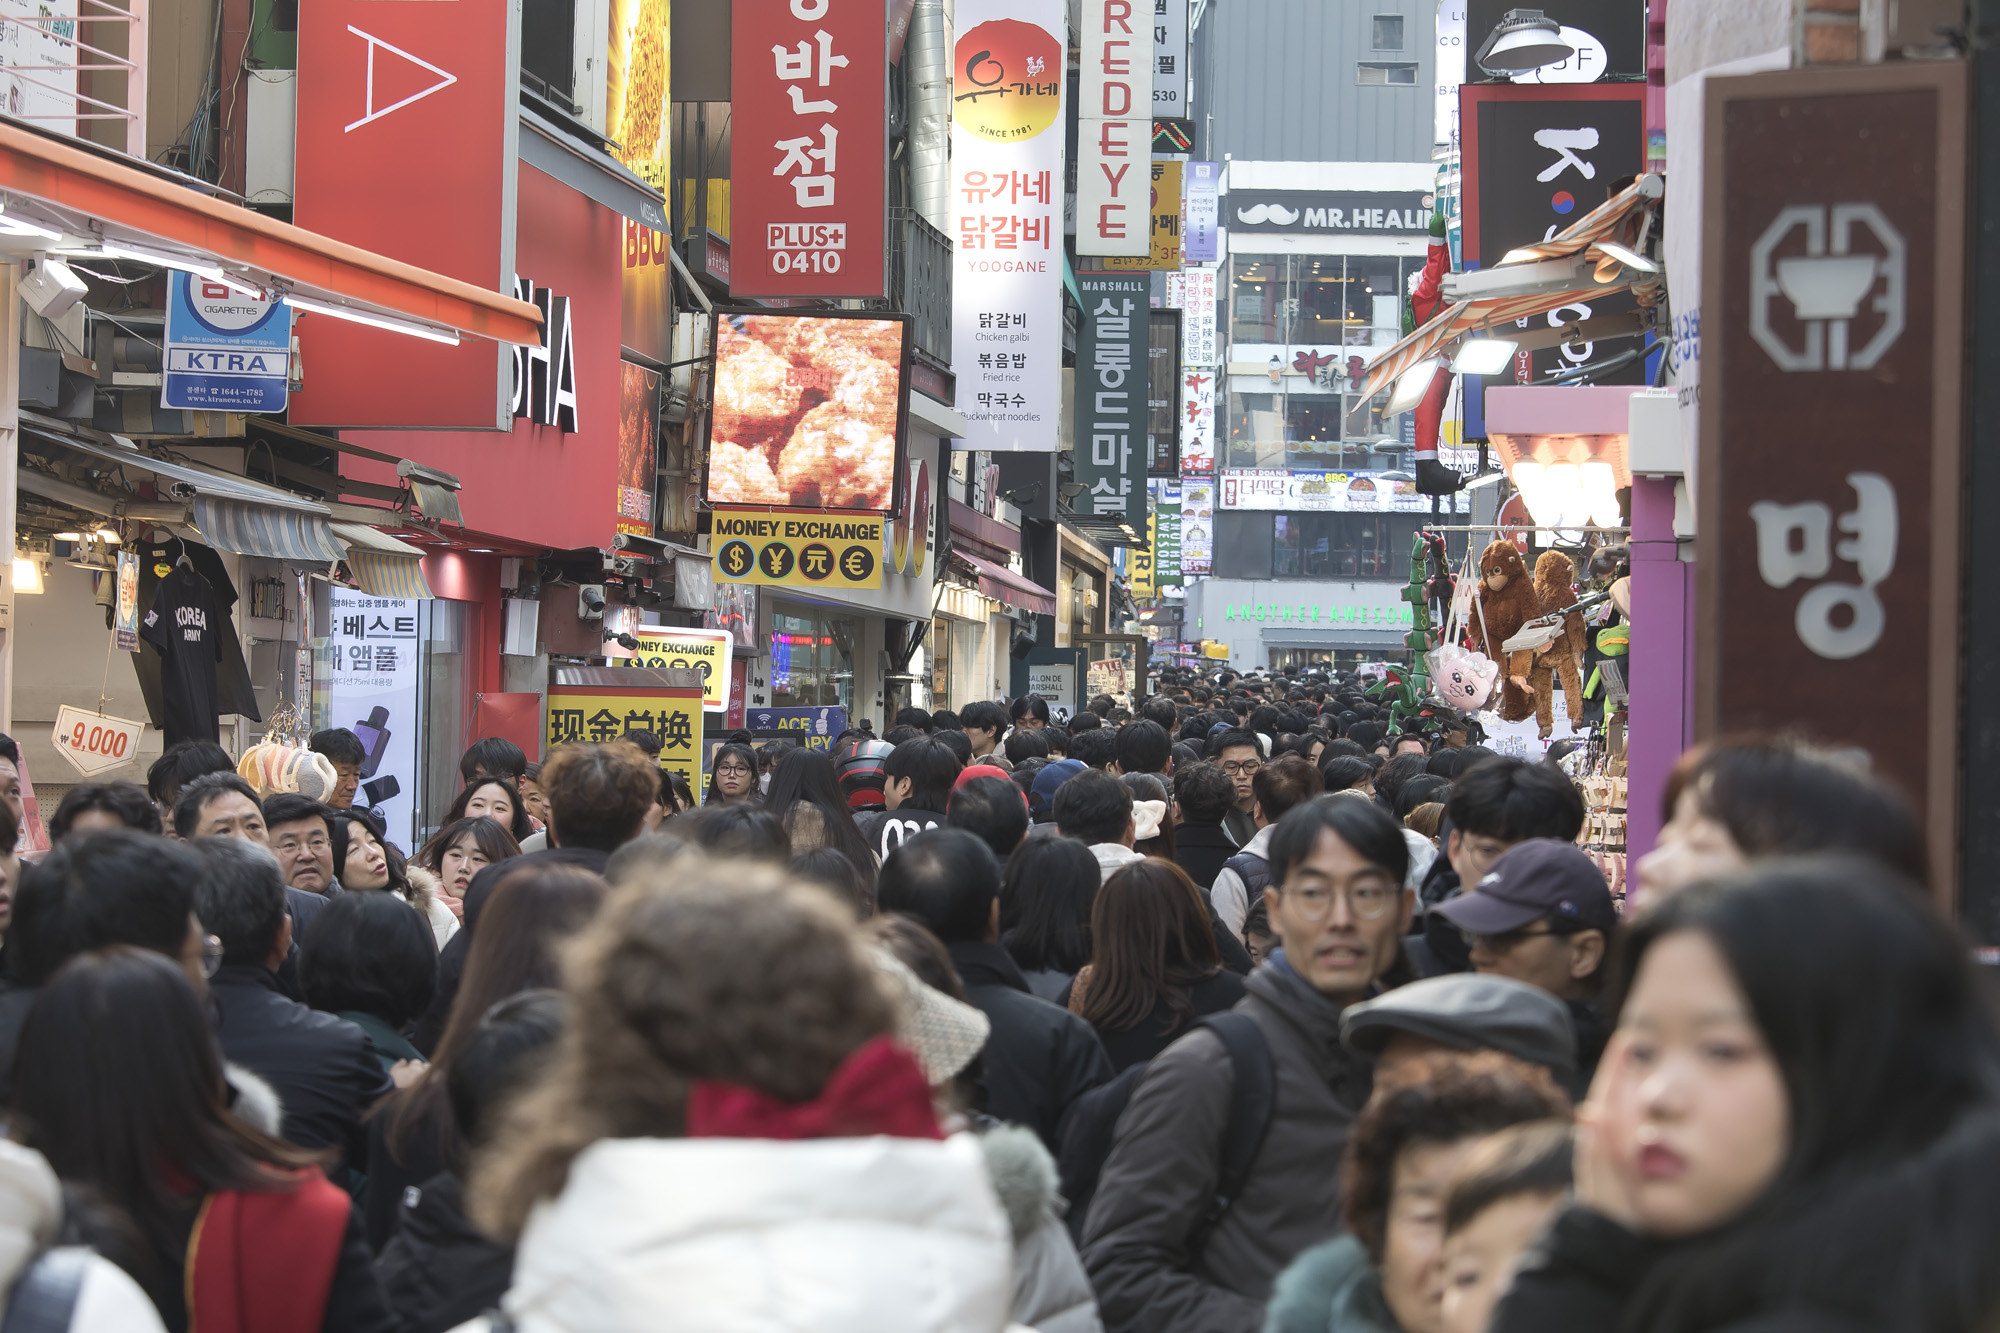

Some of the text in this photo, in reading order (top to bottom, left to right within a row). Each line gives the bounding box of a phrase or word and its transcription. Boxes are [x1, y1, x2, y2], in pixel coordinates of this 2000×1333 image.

[345, 24, 457, 133] A
[955, 50, 1058, 103] 유가네
[1097, 0, 1133, 238] REDEYE
[979, 124, 1032, 137] SINCE 1981
[961, 170, 1050, 205] 유가네
[769, 226, 844, 247] PLUS+
[960, 215, 1050, 250] 닭갈비
[626, 217, 665, 269] BBQ
[1161, 247, 1179, 260] 3F
[772, 251, 841, 273] 0410
[968, 261, 1046, 272] YOOGANE
[1082, 281, 1144, 292] MARSHALL
[205, 305, 257, 315] CIGARETTES
[979, 313, 1026, 328] 닭갈비
[975, 333, 1030, 343] Chicken galbi
[187, 352, 268, 372] KTRA
[977, 353, 1027, 369] 볶음밥
[983, 373, 1020, 381] Fried rice
[221, 388, 264, 396] 1644-1785
[977, 392, 1026, 408] 막국수
[1090, 298, 1135, 516] 살롱드마샬
[1008, 412, 1041, 421] noodles
[1294, 472, 1348, 483] KOREA BBQ
[1240, 480, 1286, 495] 더식당
[716, 519, 880, 541] MONEY EXCHANGE
[1156, 513, 1170, 576] AWESOME
[1169, 513, 1181, 576] ANOTHER
[1749, 470, 1898, 659] 명
[358, 599, 373, 608] 집중
[374, 599, 389, 608] 앰플
[391, 599, 406, 608] 케어
[175, 606, 207, 631] KOREA
[1226, 604, 1412, 624] ANOTHER AWESOM
[183, 628, 201, 642] ARMY
[343, 614, 417, 640] 베스트
[637, 641, 715, 656] ONEY EXCHANGE
[348, 645, 399, 671] 앰플
[353, 678, 371, 686] 75ml
[371, 678, 393, 686] 대용량
[1030, 675, 1062, 683] ALON DE
[777, 717, 811, 732] ACE
[71, 722, 128, 758] 9,000
